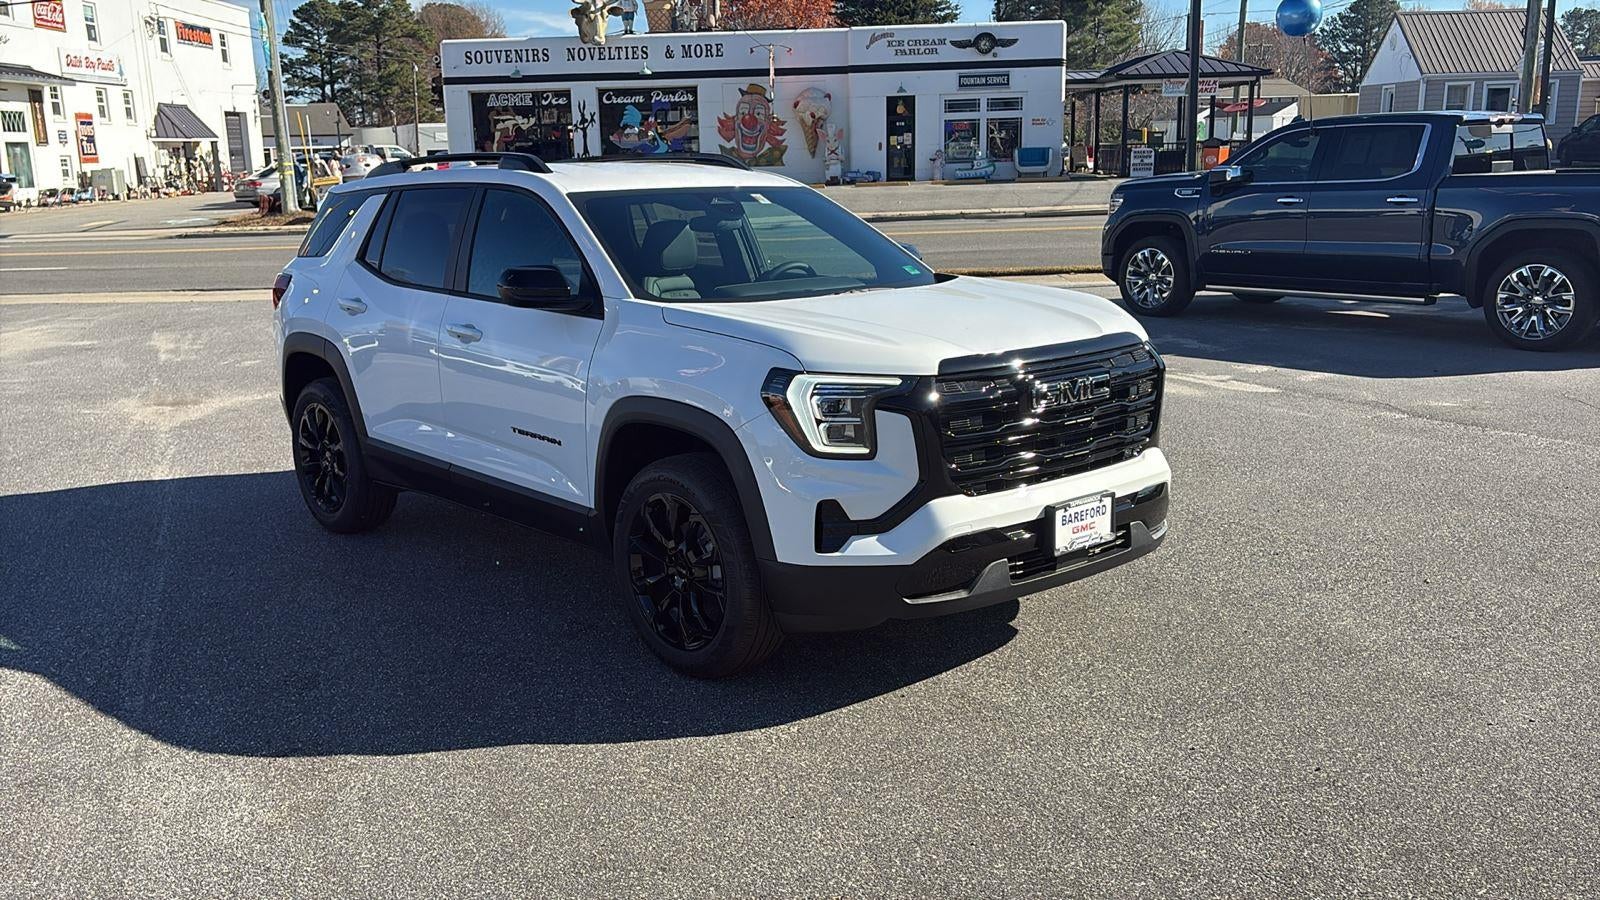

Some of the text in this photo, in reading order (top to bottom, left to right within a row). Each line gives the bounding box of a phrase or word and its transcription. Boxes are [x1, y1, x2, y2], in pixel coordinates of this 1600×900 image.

[887, 38, 947, 48] ICE CREAM
[464, 43, 724, 65] SOUVENIRS NOVELTIES & MORE
[894, 47, 939, 56] PARLOR
[66, 54, 115, 72] Dutch Boy Paints
[960, 75, 1008, 86] FOUNTAIN SERVICE
[487, 93, 568, 107] ACME Ice
[602, 90, 695, 105] Cream Parlor
[1031, 374, 1110, 411] GMC
[510, 427, 561, 446] TERRAIN
[1061, 505, 1107, 526] BAREFORD
[1071, 521, 1096, 535] GMC
